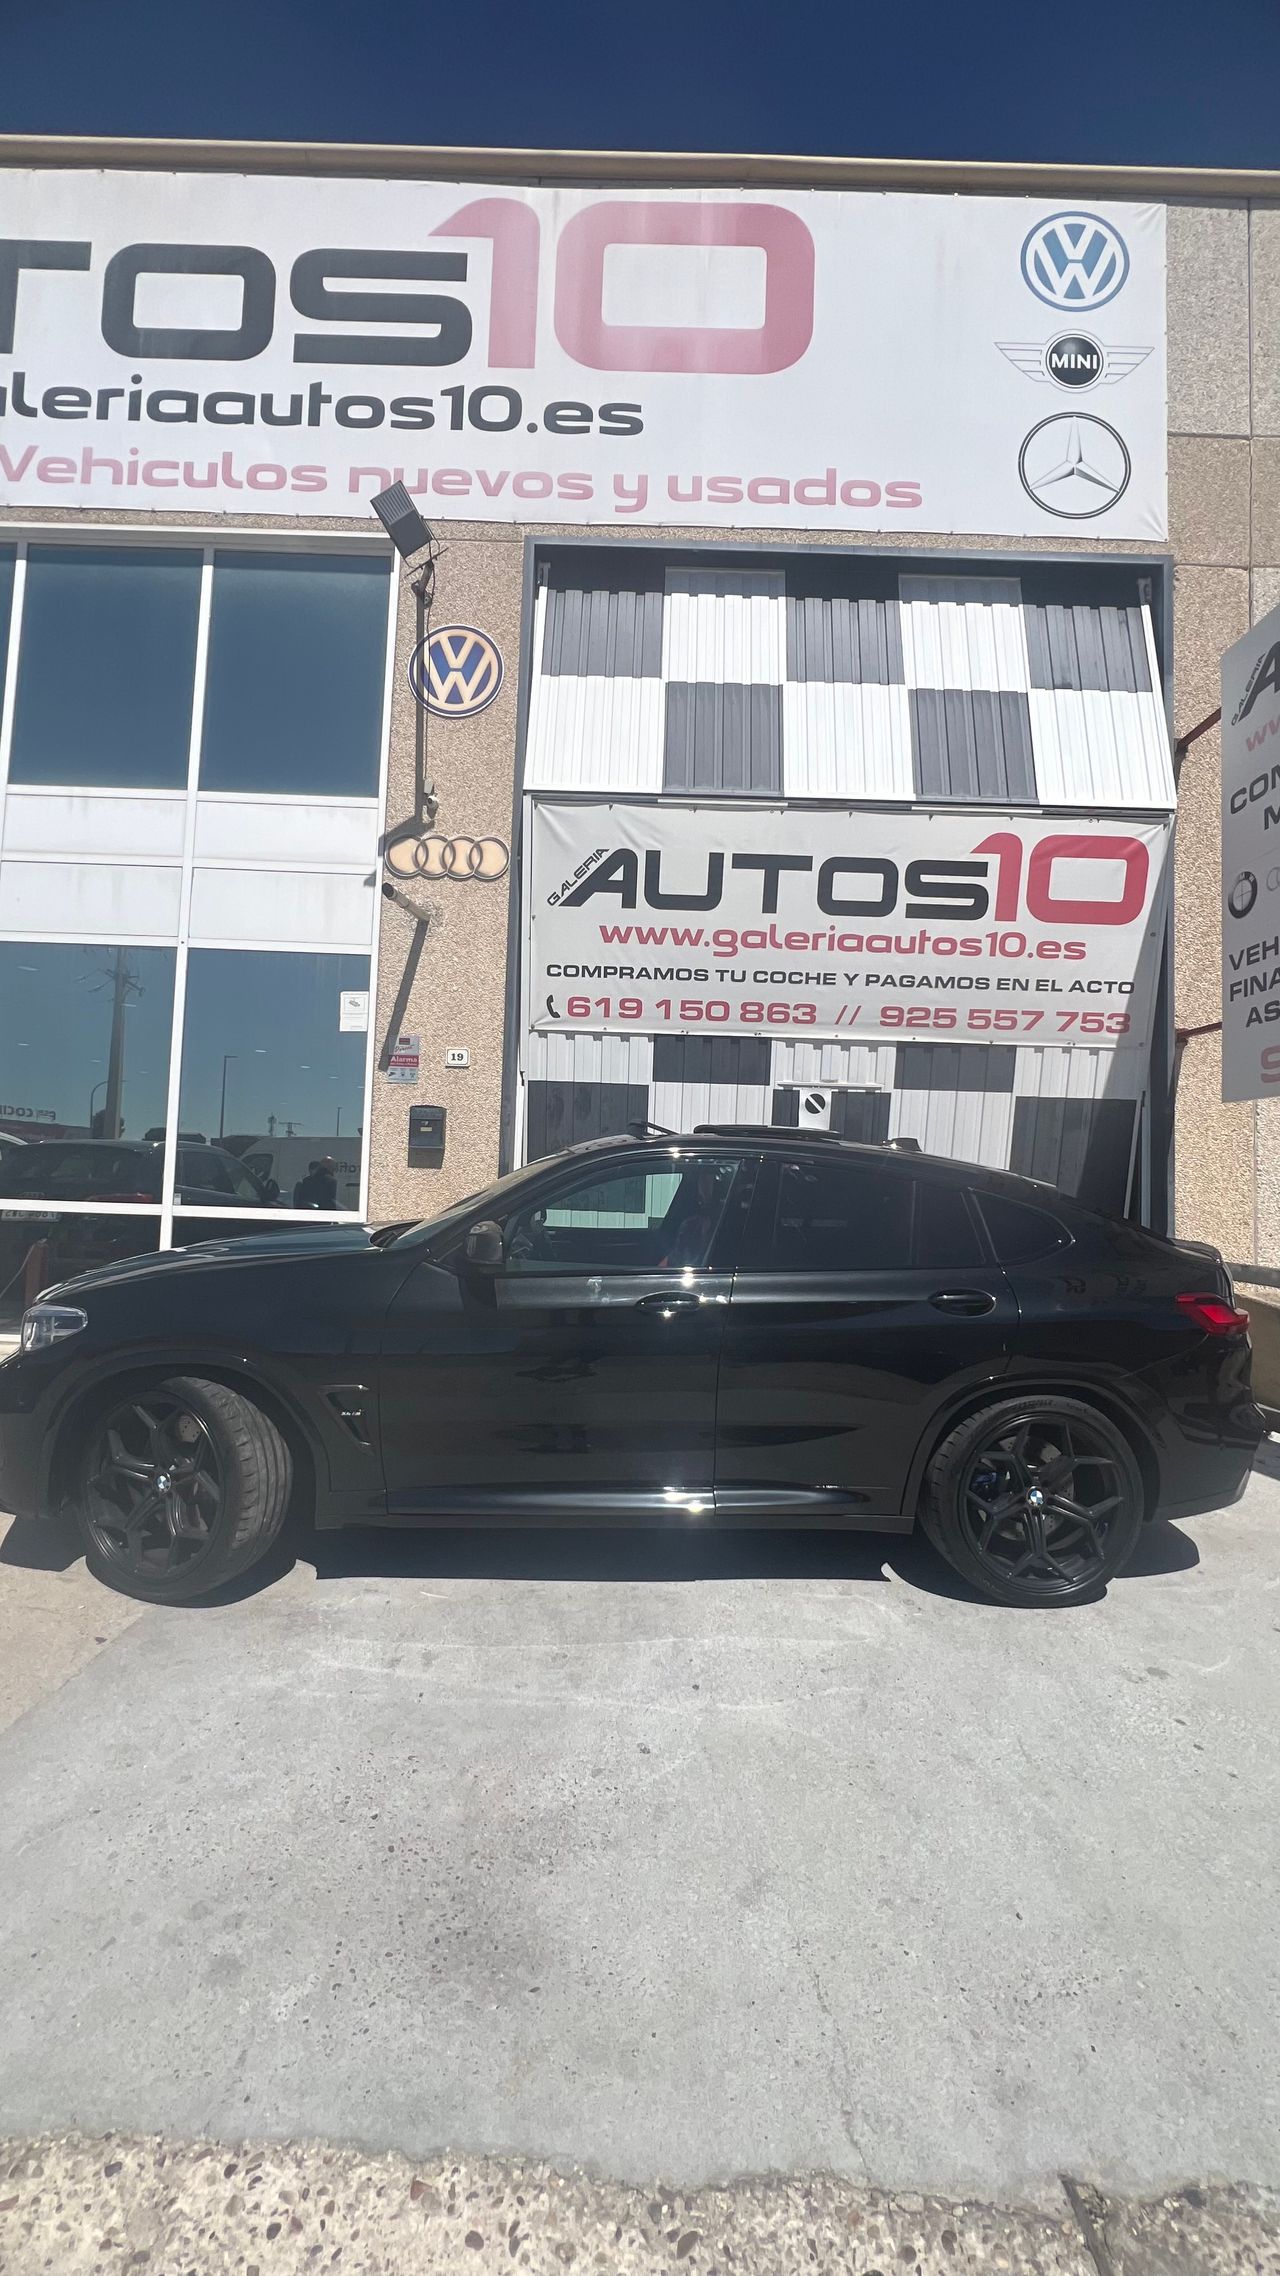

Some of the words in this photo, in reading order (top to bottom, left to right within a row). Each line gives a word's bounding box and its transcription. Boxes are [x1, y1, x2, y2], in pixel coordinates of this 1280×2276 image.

[1051, 353, 1098, 370] MINI
[0, 371, 644, 436] leriaautos10.es
[0, 445, 328, 493] Vehiculos
[348, 468, 593, 501] nuevos
[614, 475, 648, 514] y
[667, 469, 922, 509] usados
[1231, 652, 1266, 726] GALERIA
[546, 848, 610, 907] GALERIA
[559, 832, 1149, 926] AUTOS10
[600, 925, 1087, 961] www.galeriaautos10.es
[1228, 935, 1280, 971] VEH
[546, 964, 709, 983] COMPRAMOS
[715, 969, 747, 984] TU
[752, 970, 837, 986] COCHE
[843, 973, 861, 987] Y
[865, 973, 990, 990] PAGAMOS
[996, 977, 1031, 992] EN
[1035, 979, 1064, 993] EL
[1068, 980, 1136, 995] ACTO
[566, 996, 643, 1019] 619
[656, 998, 730, 1022] 150
[740, 1002, 817, 1025] 863
[879, 1007, 957, 1029] 925
[967, 1009, 1050, 1031] 557
[1056, 1011, 1131, 1034] 753
[390, 1055, 418, 1064] Alarma
[451, 1053, 464, 1062] 19
